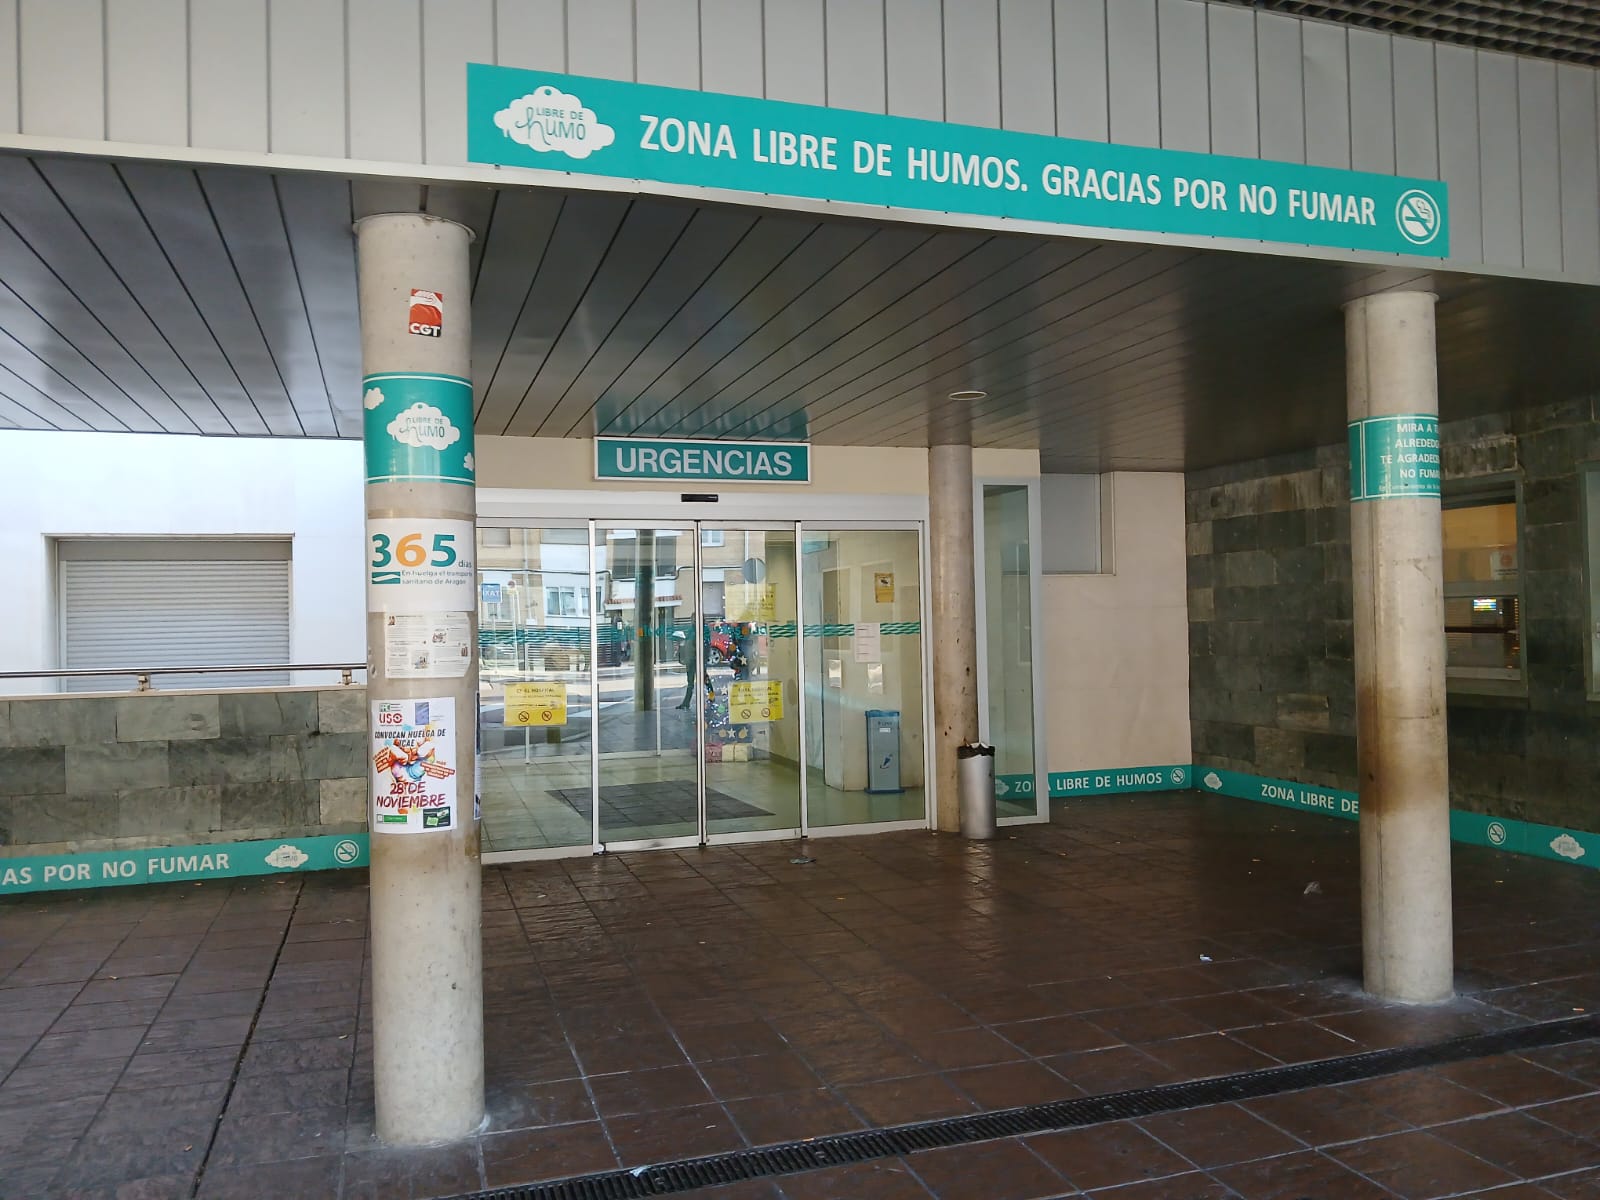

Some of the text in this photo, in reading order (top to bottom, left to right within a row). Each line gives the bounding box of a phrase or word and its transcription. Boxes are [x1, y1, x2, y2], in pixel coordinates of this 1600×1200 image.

[536, 107, 584, 121] LIBRE DE
[639, 114, 1377, 226] ZONA LIBRE DE HUMOS. GRACIAS POR NO FUMAR
[410, 322, 441, 337] CGT
[1396, 423, 1424, 433] MIRA
[1426, 424, 1433, 433] A
[616, 447, 793, 476] URGENCIAS
[1380, 454, 1393, 464] TE
[1400, 469, 1416, 478] NO
[371, 533, 457, 568] 365
[379, 713, 403, 724] USO
[374, 728, 447, 739] CONVOCAN HUELGA DE
[389, 781, 426, 795] 28 DE
[1056, 777, 1089, 791] LIBRE
[1095, 776, 1111, 788] DE
[1116, 772, 1163, 787] HUMOS
[376, 793, 447, 809] NOVIEMBRE
[1261, 783, 1359, 814] ZONA LIBRE DE
[43, 864, 91, 883] POR
[102, 860, 137, 879] NO
[147, 852, 230, 876] FUMAR
